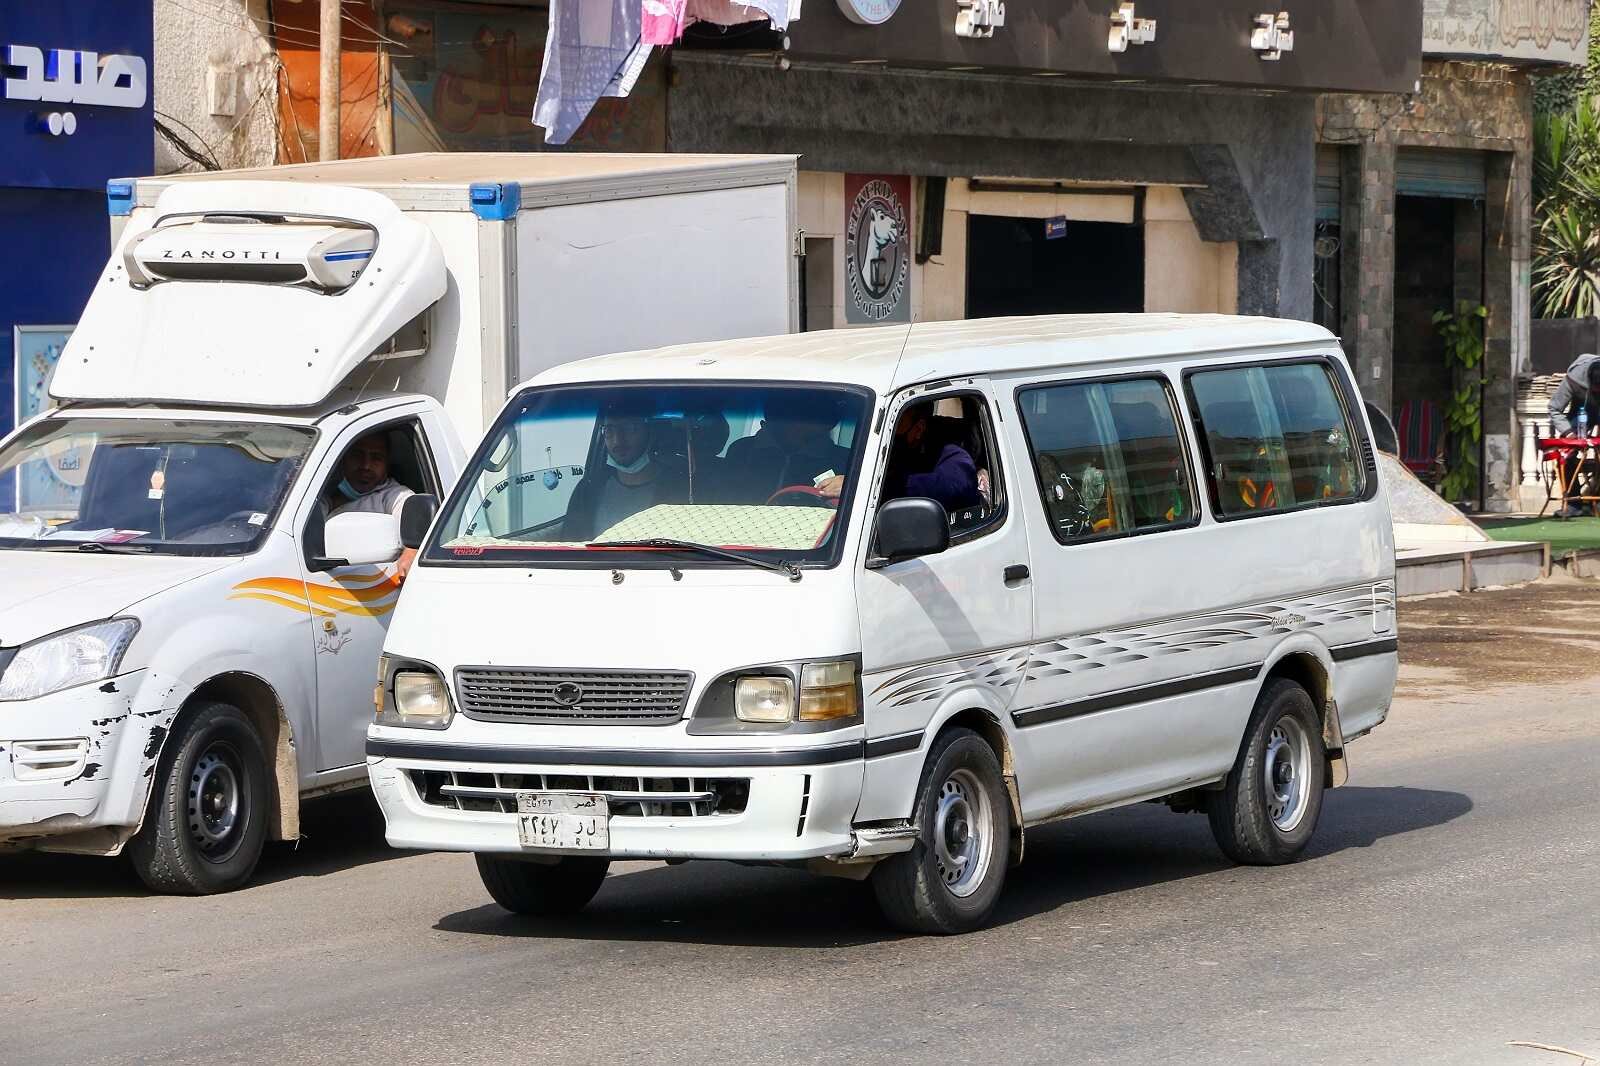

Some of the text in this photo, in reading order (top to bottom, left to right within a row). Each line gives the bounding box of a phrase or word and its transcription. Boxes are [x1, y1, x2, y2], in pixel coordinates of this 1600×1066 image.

[6, 44, 147, 136] صيد
[163, 250, 280, 260] ZANOTTI
[847, 253, 862, 309] King
[862, 301, 873, 318] of
[874, 302, 893, 320] The
[574, 801, 597, 809] مصر
